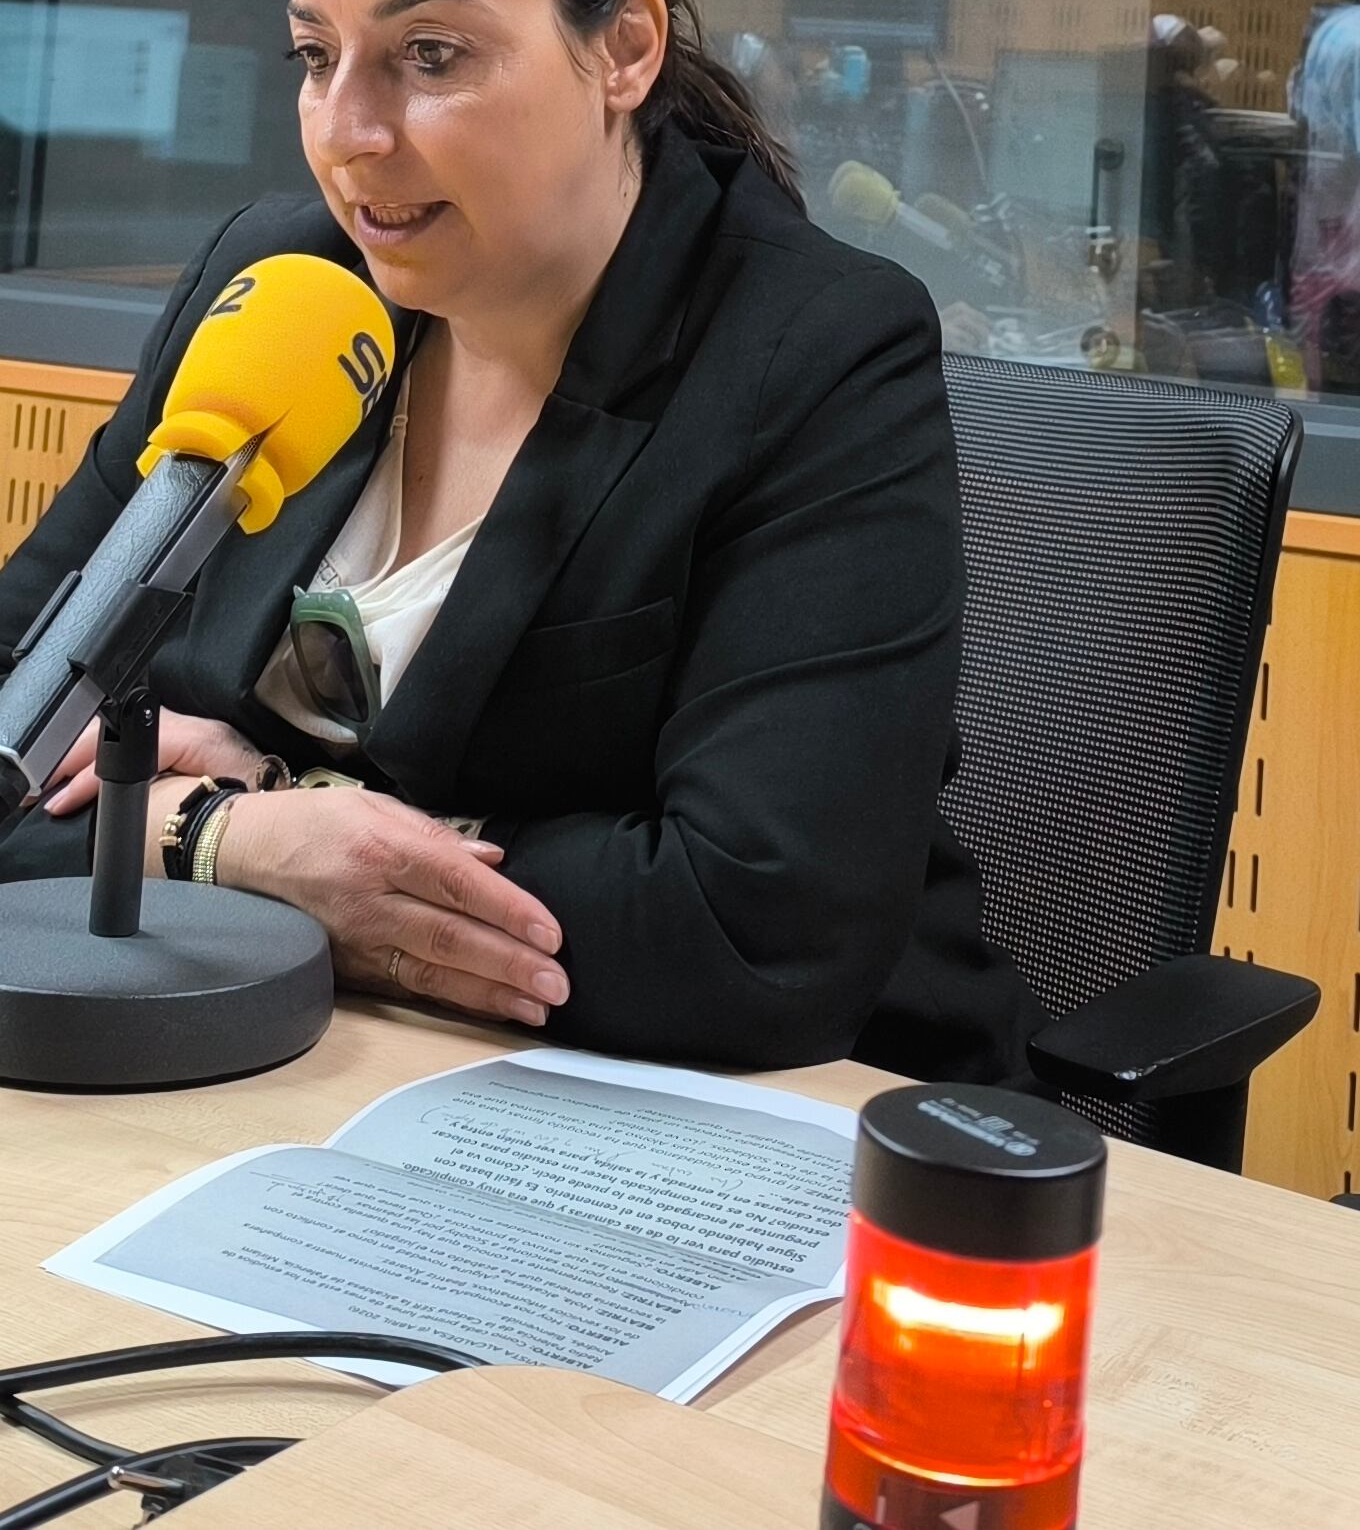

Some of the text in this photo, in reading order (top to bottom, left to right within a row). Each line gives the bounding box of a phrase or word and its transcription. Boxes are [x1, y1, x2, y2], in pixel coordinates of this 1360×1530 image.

[431, 1130, 478, 1145] colocar
[460, 1124, 494, 1137] entra
[496, 1132, 533, 1147] quién
[480, 1142, 511, 1154] para
[533, 1144, 555, 1154] ver
[558, 1150, 591, 1161] para
[511, 1151, 559, 1166] estudio
[593, 1156, 633, 1173] salida,
[561, 1163, 579, 1172] un
[634, 1170, 648, 1179] la
[580, 1169, 618, 1184] hacer
[620, 1179, 698, 1203] complicado
[661, 1177, 714, 1194] entrada
[449, 1147, 820, 1248] preguntar al encargado que lo puede decir. ¿Cómo va el
[716, 1191, 730, 1200] la
[732, 1195, 751, 1203] en
[433, 1156, 807, 1262] Sigue habiendo robos en el cementerio. Es fácil basta con
[700, 1200, 723, 1211] tan
[753, 1201, 812, 1220] cámaras
[402, 1161, 795, 1273] estudio para ver lo de las cámaras y que era muy complicado.
[745, 1212, 767, 1223] No
[815, 1217, 842, 1228] dos
[767, 1218, 830, 1237] estudio?
